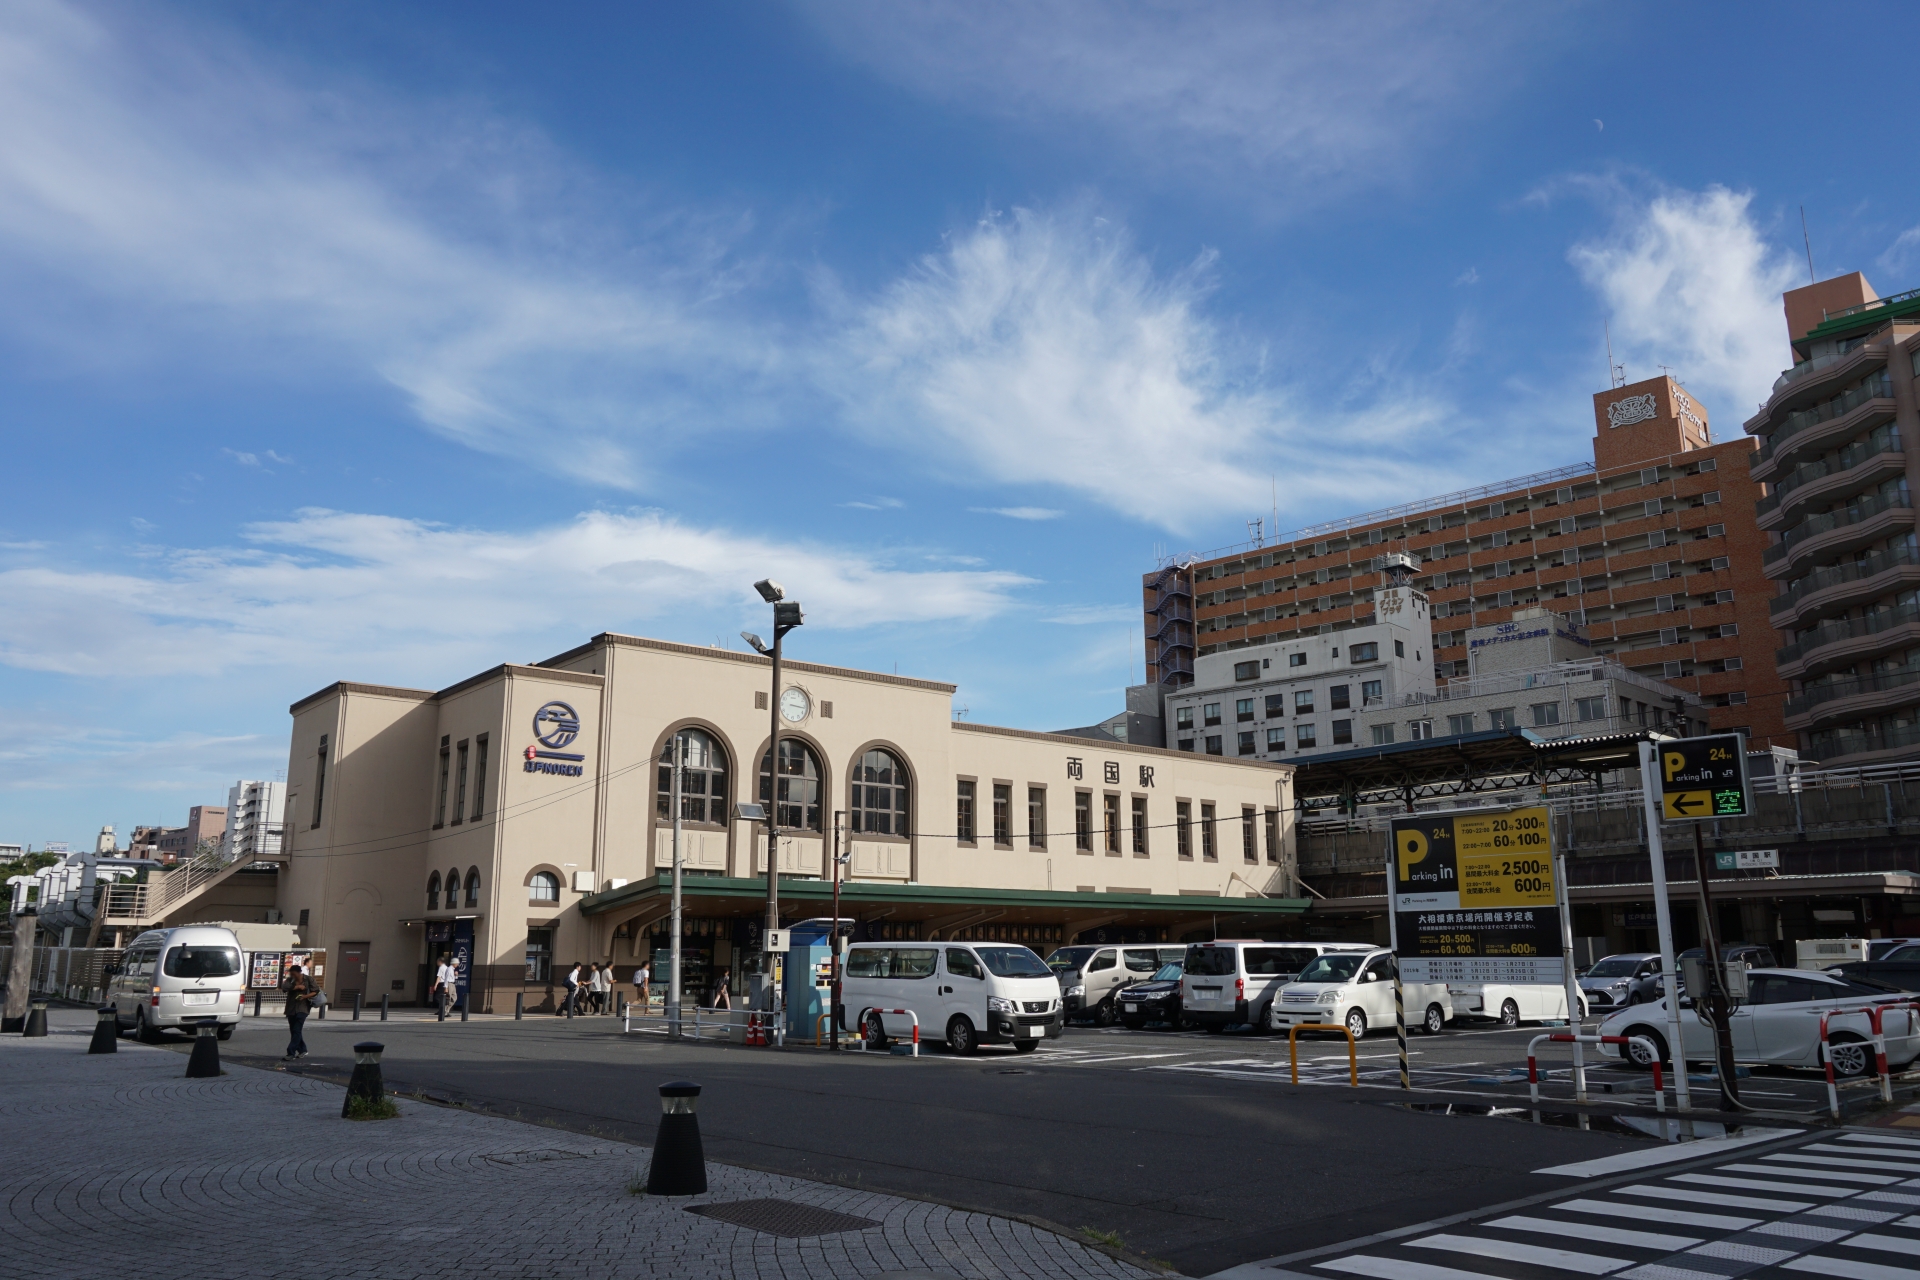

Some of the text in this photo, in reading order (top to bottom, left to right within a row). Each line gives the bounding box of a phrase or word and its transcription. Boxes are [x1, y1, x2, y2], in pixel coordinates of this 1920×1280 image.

[1710, 748, 1732, 760] 24H
[1066, 756, 1155, 788] 両国駅
[1700, 768, 1712, 779] in
[1715, 790, 1742, 814] 空
[1433, 828, 1450, 839] 24H
[1720, 852, 1772, 864] JR 両国駅
[1439, 864, 1453, 879] in
[1466, 870, 1500, 878] 昼間最大料金
[1514, 878, 1550, 892] 600円
[1418, 911, 1534, 924] 大相撲東京場所開催予定表
[1510, 943, 1537, 954] 600円
